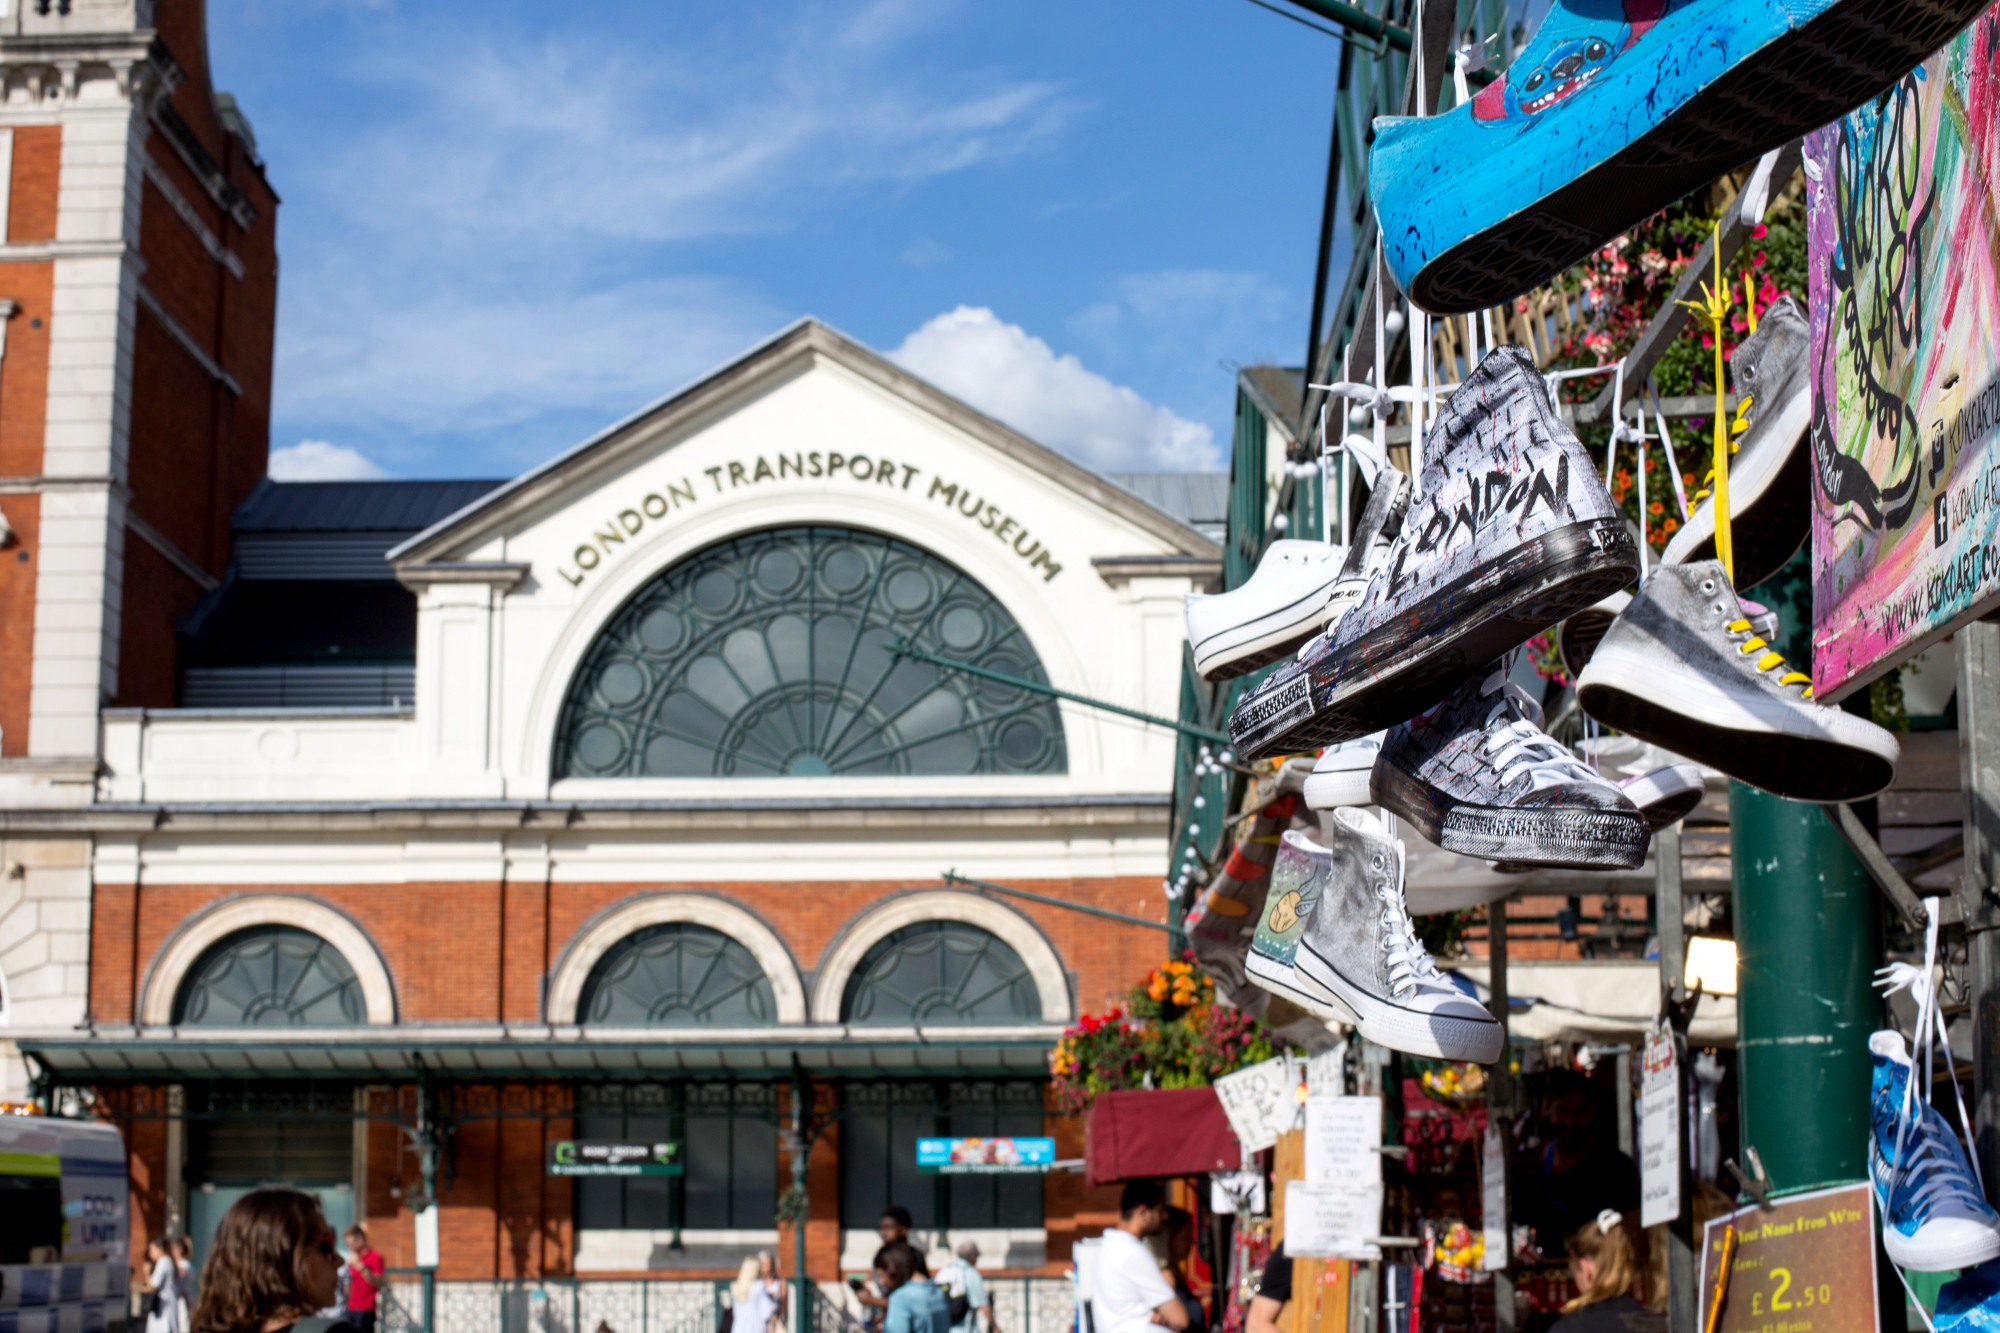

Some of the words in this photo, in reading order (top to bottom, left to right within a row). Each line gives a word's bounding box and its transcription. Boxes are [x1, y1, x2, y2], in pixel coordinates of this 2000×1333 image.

[1813, 414, 1844, 498] London
[557, 476, 697, 588] LONDON
[705, 450, 920, 492] TRANSPORT
[927, 476, 1063, 583] MUSEUM
[1385, 455, 1569, 601] LONDON
[1761, 1222, 1794, 1239] Name
[1796, 1216, 1827, 1232] From
[1828, 1208, 1862, 1225] Wire
